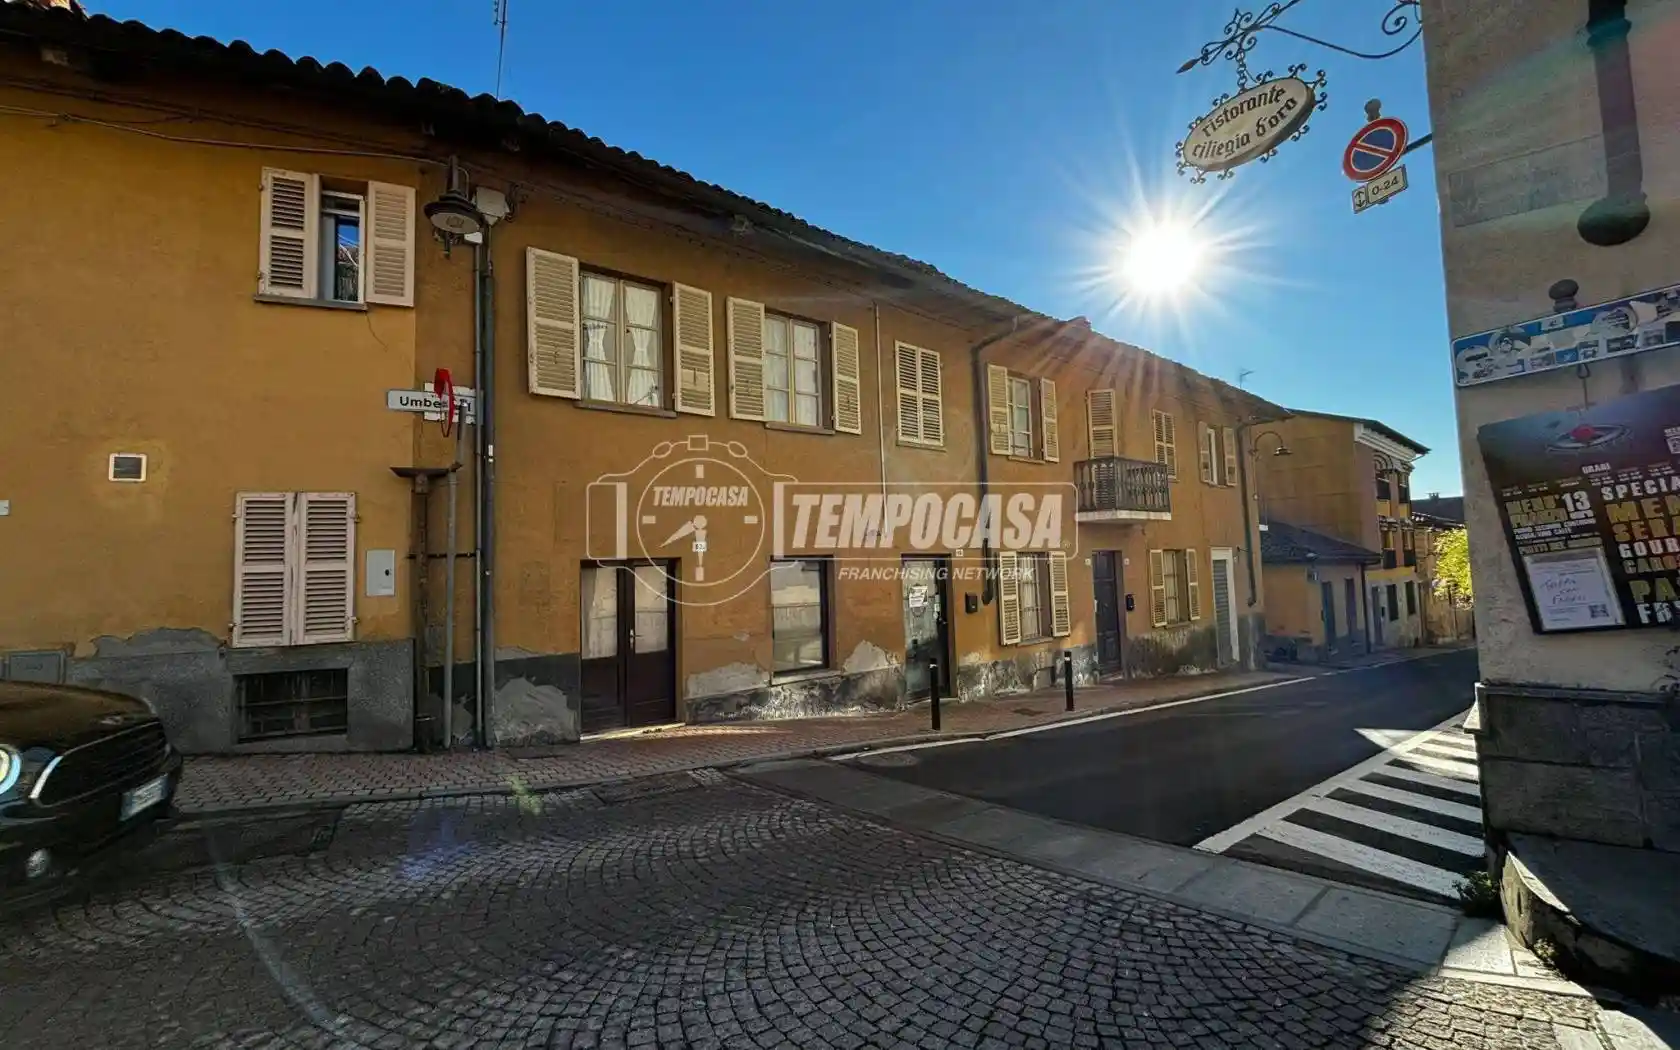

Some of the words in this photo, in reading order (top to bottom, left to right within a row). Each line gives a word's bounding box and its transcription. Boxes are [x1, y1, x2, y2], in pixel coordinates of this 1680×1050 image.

[1202, 85, 1286, 138] ristorante
[1191, 132, 1251, 160] ciliegia
[1371, 176, 1399, 195] 0-24
[1562, 490, 1591, 512] 13
